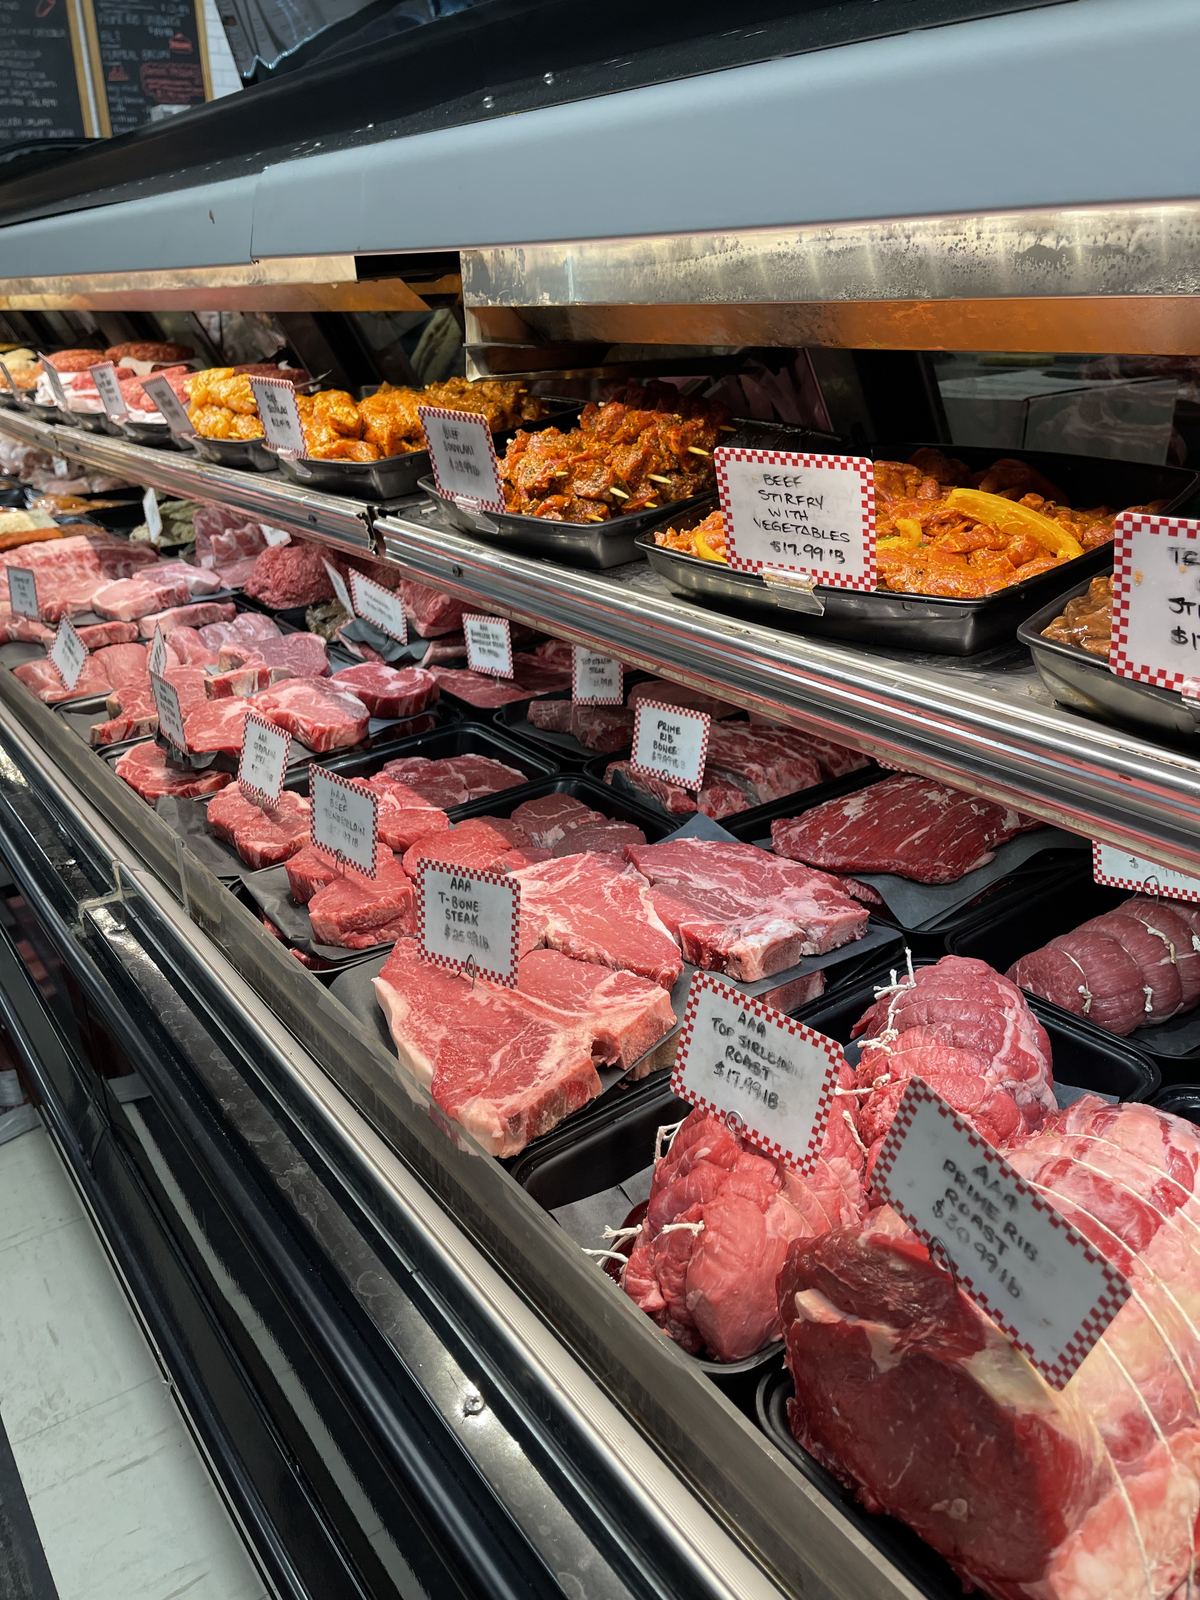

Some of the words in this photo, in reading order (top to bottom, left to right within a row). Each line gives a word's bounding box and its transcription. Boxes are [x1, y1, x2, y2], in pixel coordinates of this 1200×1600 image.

[763, 474, 804, 488] BEEF
[758, 489, 824, 511] STIRFRY
[768, 508, 809, 522] WITH
[753, 517, 851, 543] VEGETABLES
[657, 720, 681, 735] PRIME
[660, 732, 674, 744] RIB
[450, 877, 471, 893] AAA
[438, 891, 479, 912] T-BONE
[445, 908, 479, 927] STEAK
[711, 1017, 735, 1037] TOP
[738, 1011, 766, 1038] AAA
[725, 1045, 771, 1081] ROAST
[972, 1165, 1019, 1212] AAA
[942, 1159, 1002, 1222] PRIME
[1002, 1221, 1039, 1262] RIB
[944, 1188, 1010, 1256] ROAST
